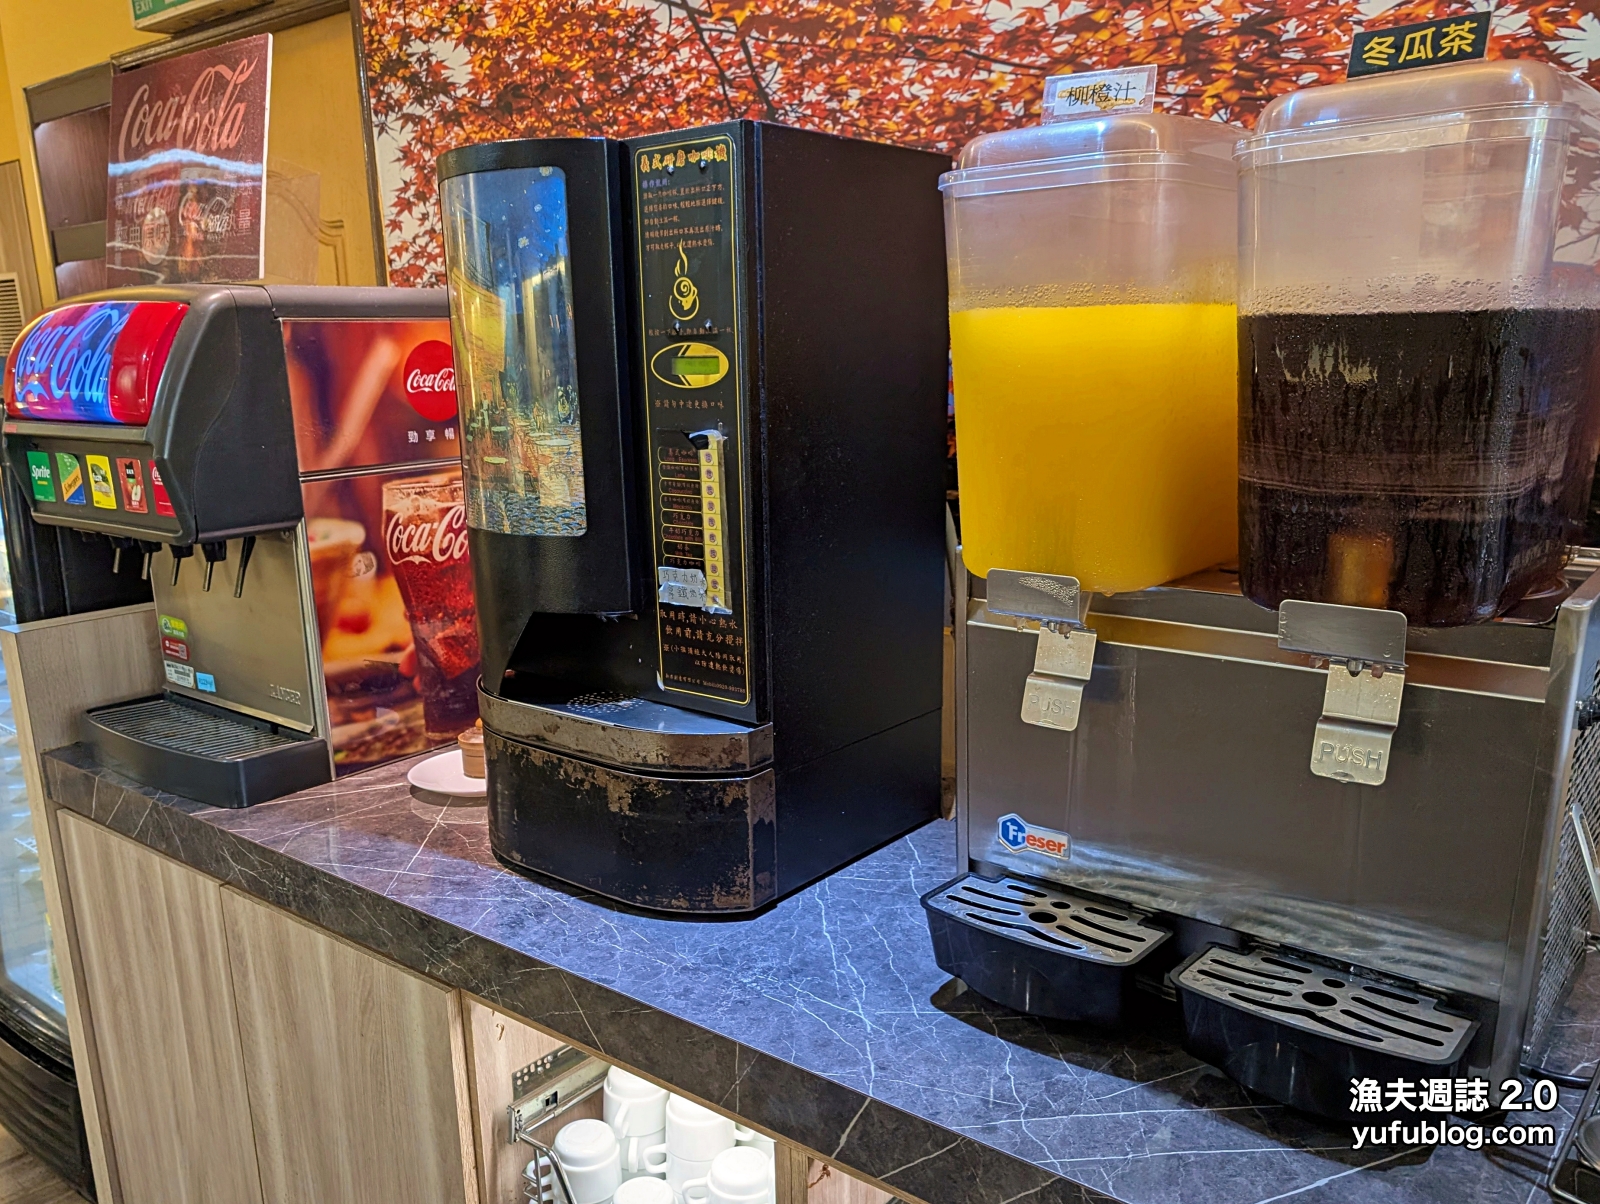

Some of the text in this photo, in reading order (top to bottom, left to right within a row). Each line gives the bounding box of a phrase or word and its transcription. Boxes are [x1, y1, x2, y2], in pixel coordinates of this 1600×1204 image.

[1363, 19, 1479, 67] 冬瓜茶
[1066, 80, 1137, 107] 柳橙汁
[118, 56, 259, 162] Coca-Cola
[15, 308, 130, 404] Coca-Cola
[406, 367, 456, 394] Coca-Col
[31, 464, 51, 480] Sprite
[673, 512, 691, 521] 巧克力
[386, 505, 470, 566] Coca-Co
[1028, 693, 1073, 717] PUSH
[1319, 741, 1383, 771] PUSH
